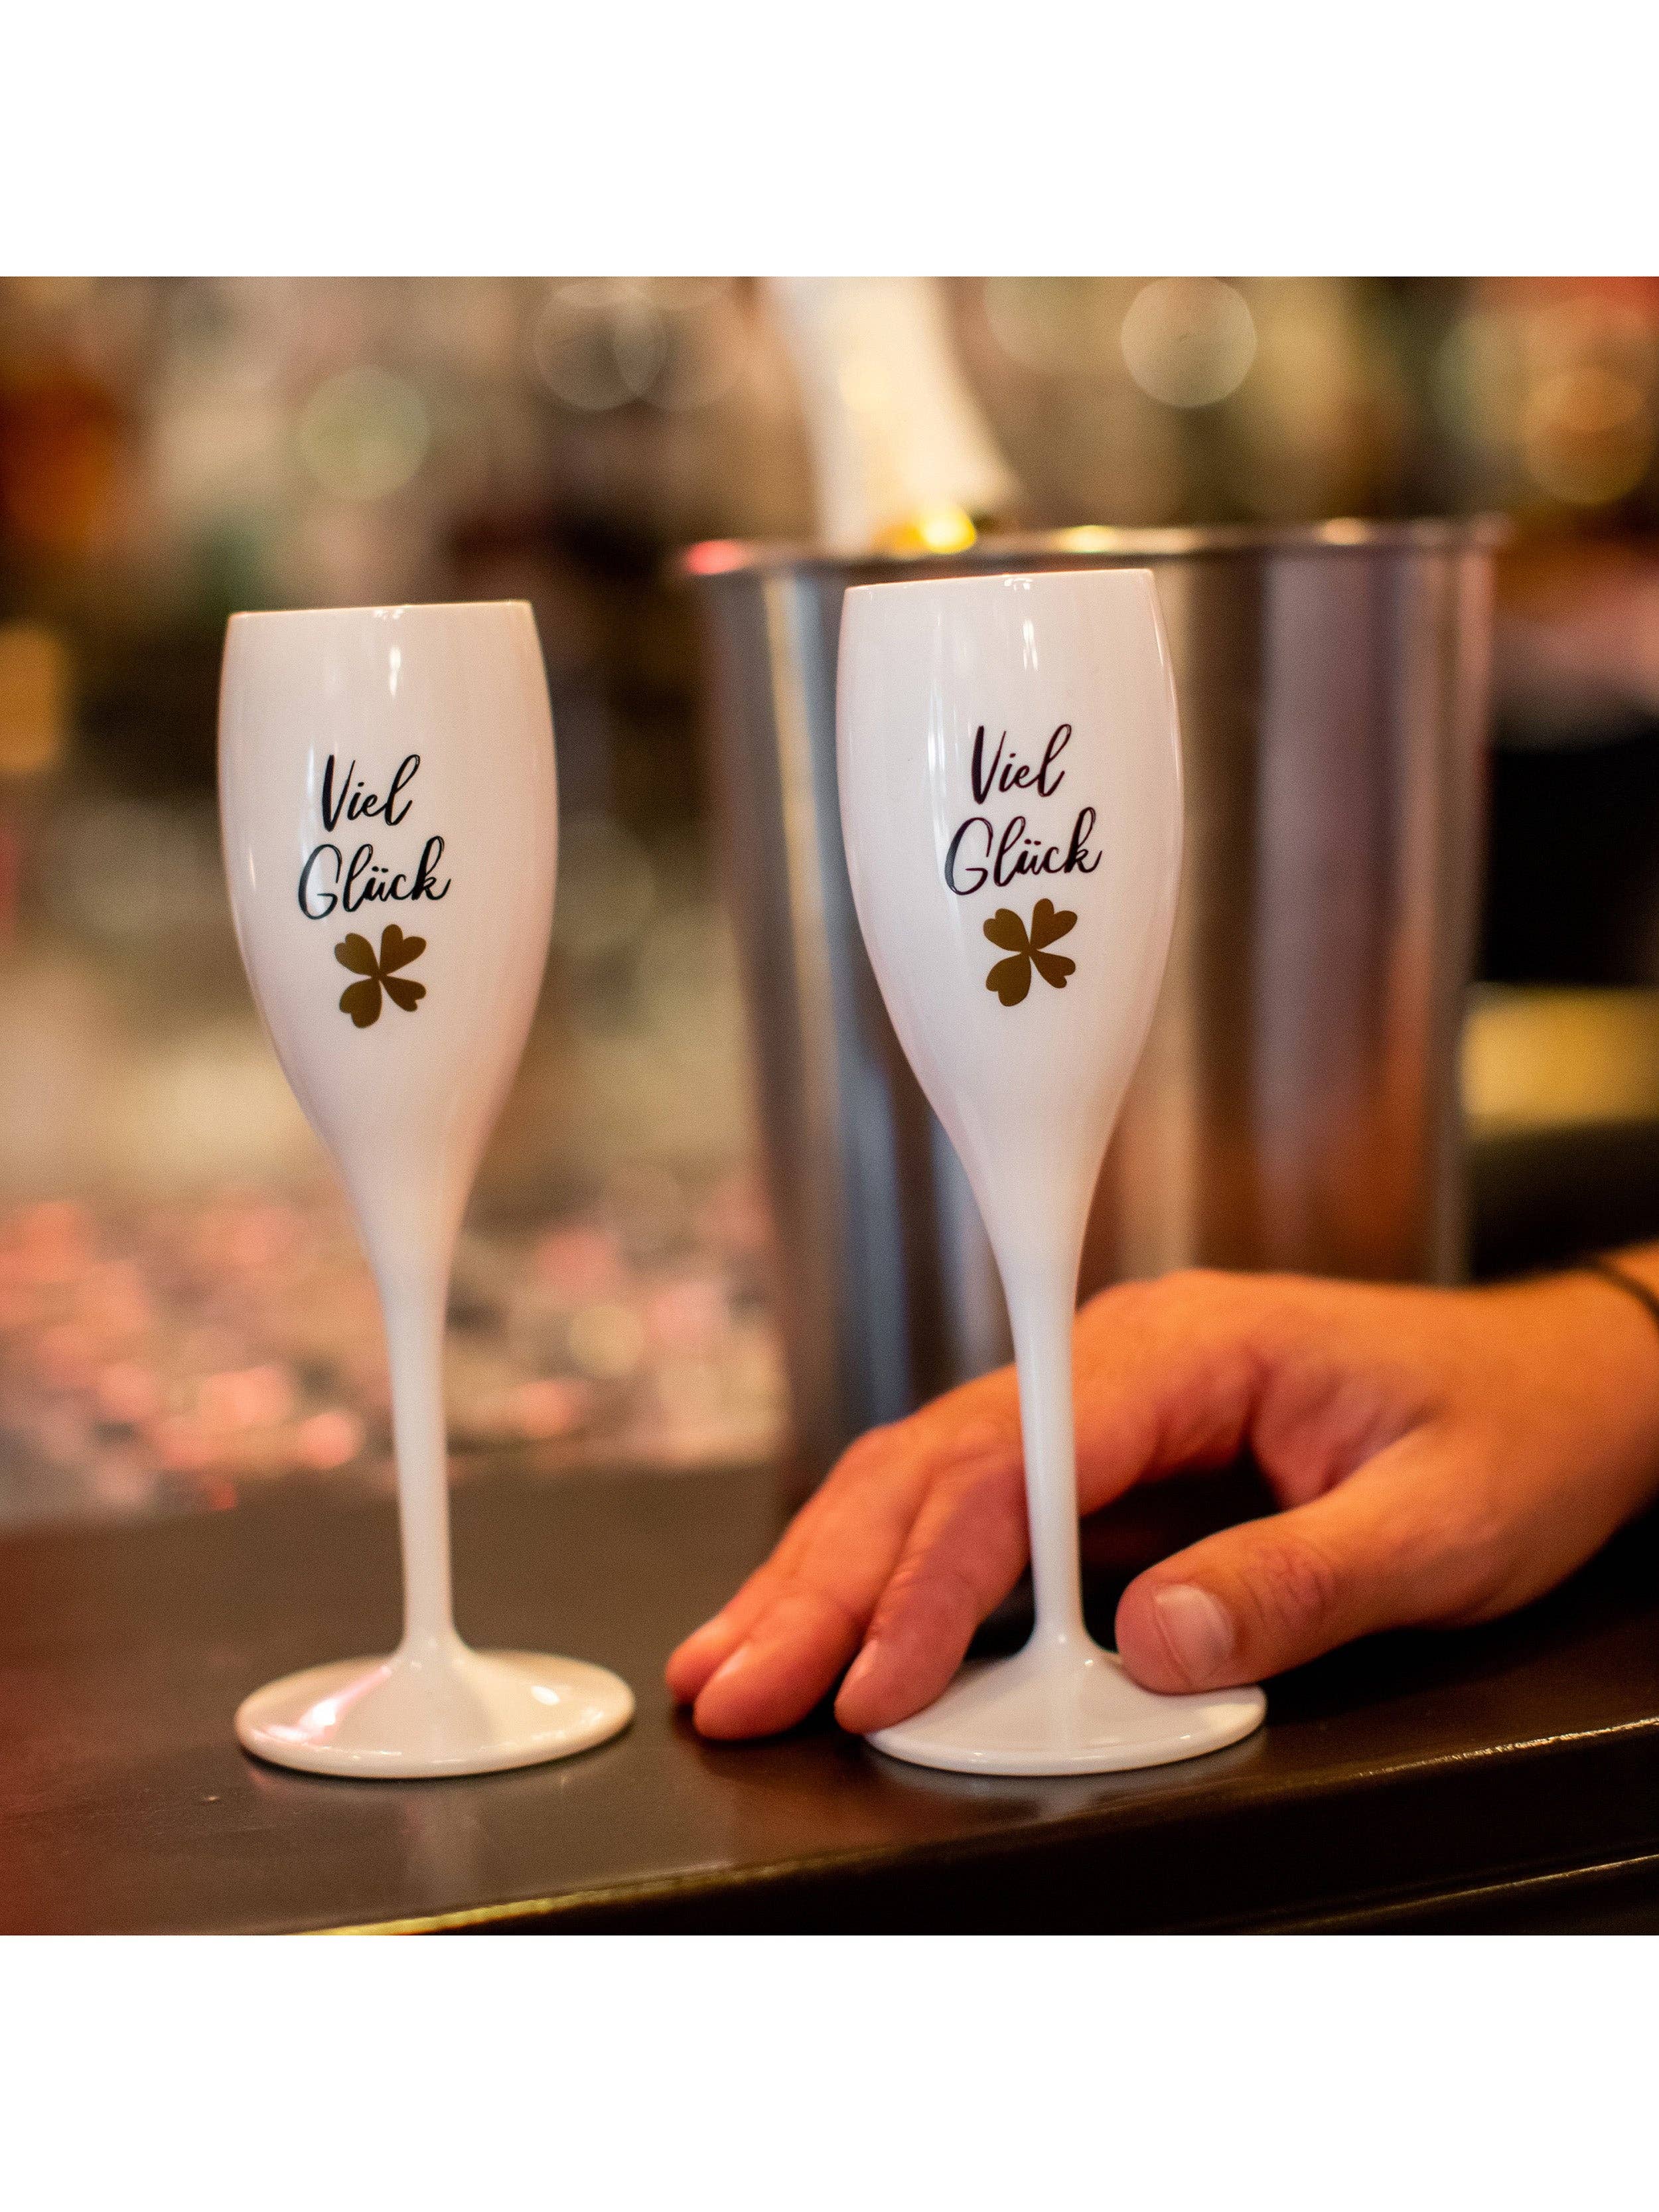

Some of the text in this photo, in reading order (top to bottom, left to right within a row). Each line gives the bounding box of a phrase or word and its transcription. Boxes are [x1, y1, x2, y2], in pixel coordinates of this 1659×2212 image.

[321, 753, 421, 833] Viel
[971, 723, 1072, 804] Viel
[297, 835, 452, 921] Glück
[944, 806, 1103, 896] Glück
